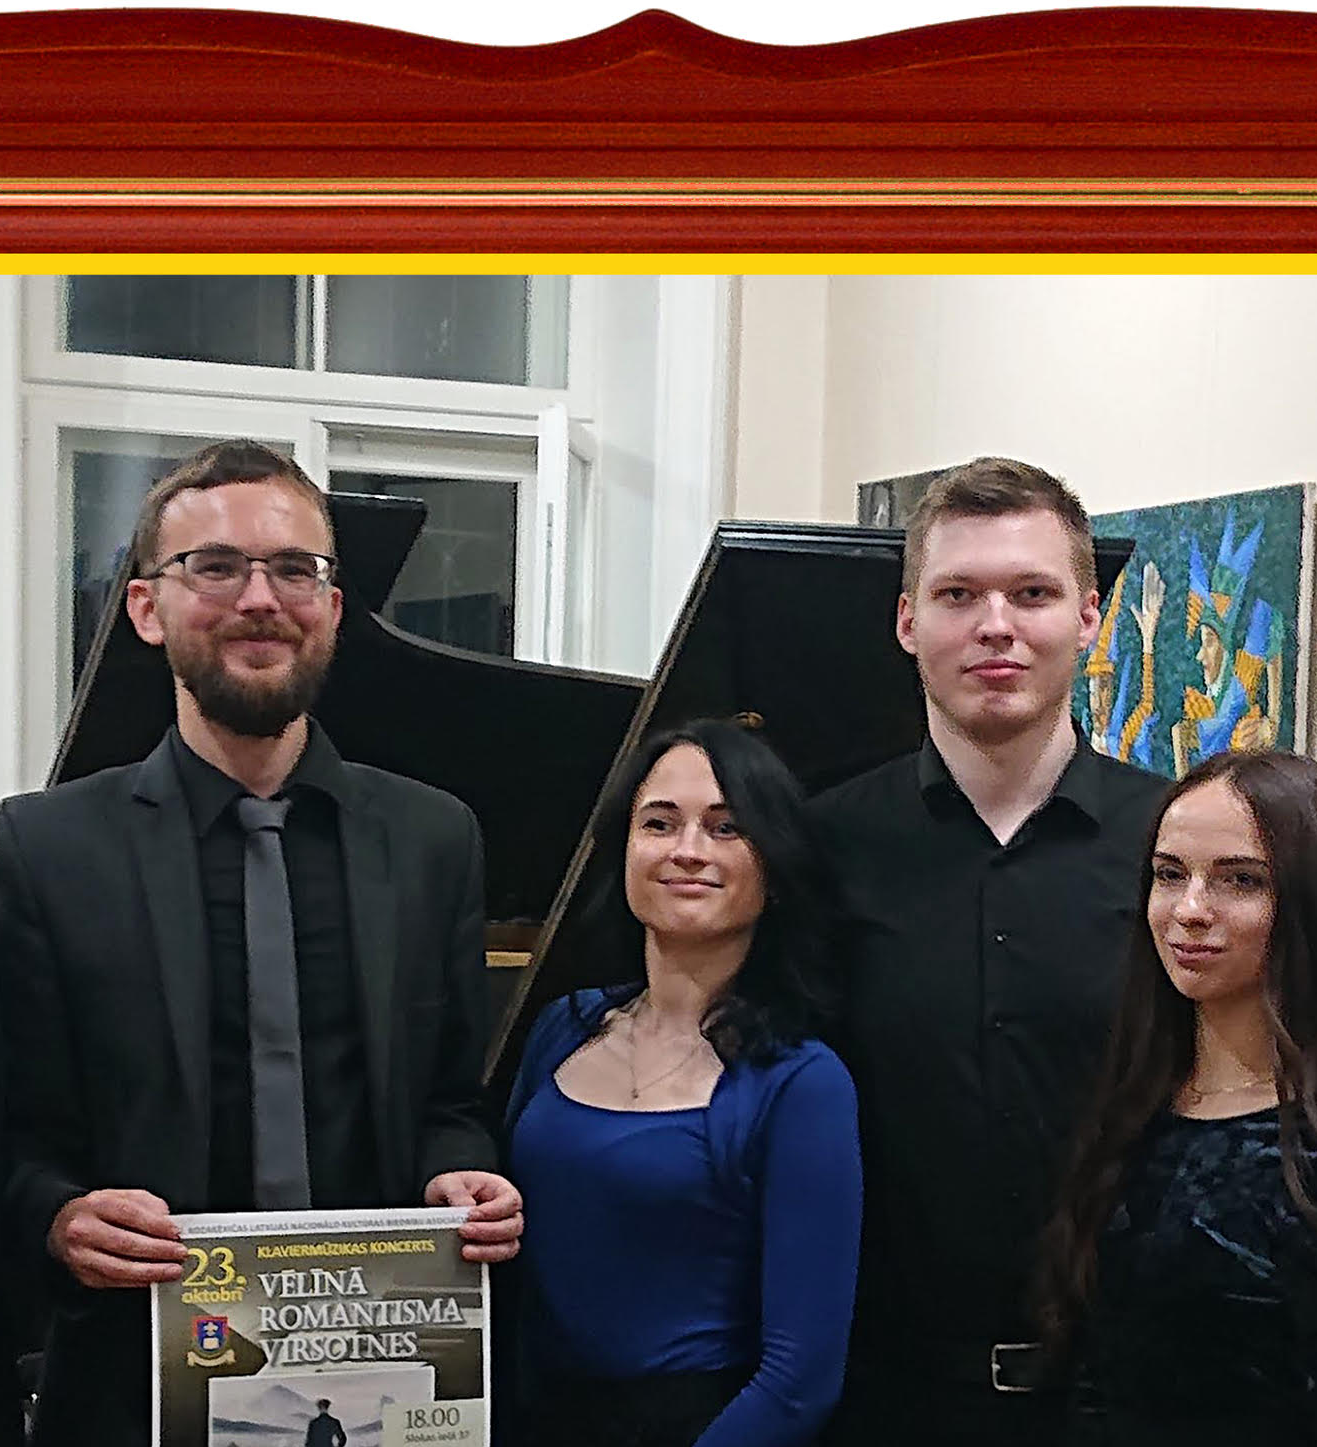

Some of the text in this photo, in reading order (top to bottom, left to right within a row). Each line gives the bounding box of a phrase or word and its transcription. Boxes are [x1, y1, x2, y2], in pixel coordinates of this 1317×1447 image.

[257, 1239, 435, 1258] KLAVIERMŪZIKAS KONCERTS
[182, 1246, 247, 1286] 23.
[258, 1266, 368, 1298] VĒLĪNĀ
[182, 1287, 245, 1304] oktobrī
[259, 1298, 464, 1332] ROMANTISMA
[260, 1332, 418, 1367] VIRSOTNES
[405, 1407, 460, 1429] 18.00
